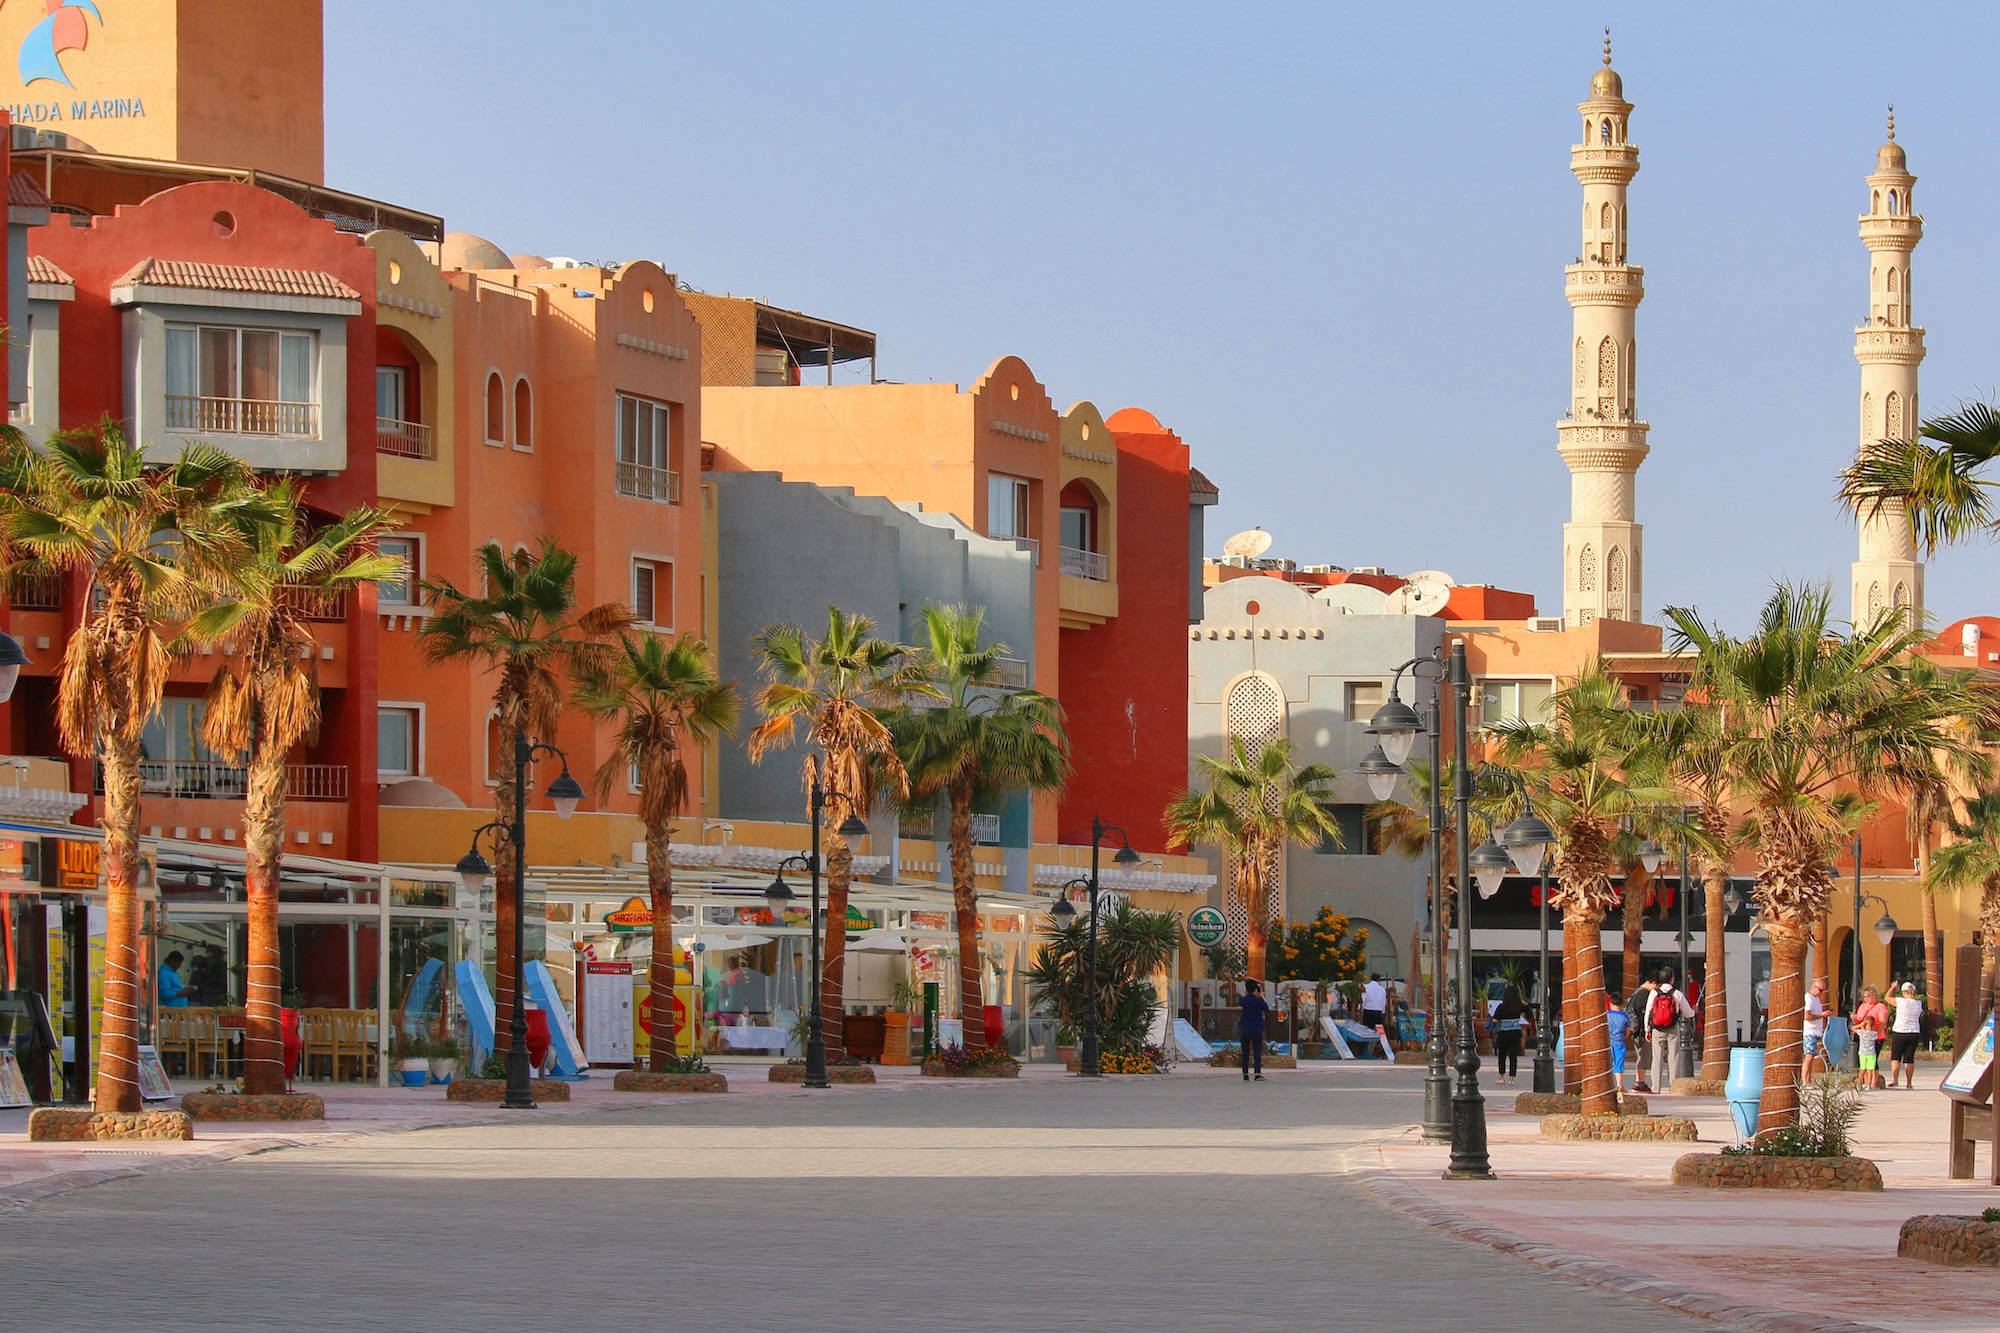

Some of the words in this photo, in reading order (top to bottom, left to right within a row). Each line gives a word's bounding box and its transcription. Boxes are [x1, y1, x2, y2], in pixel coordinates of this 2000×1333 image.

[0, 101, 62, 122] HADA
[71, 98, 145, 120] MARINA
[846, 919, 875, 929] MANS
[1190, 922, 1224, 931] Heineken
